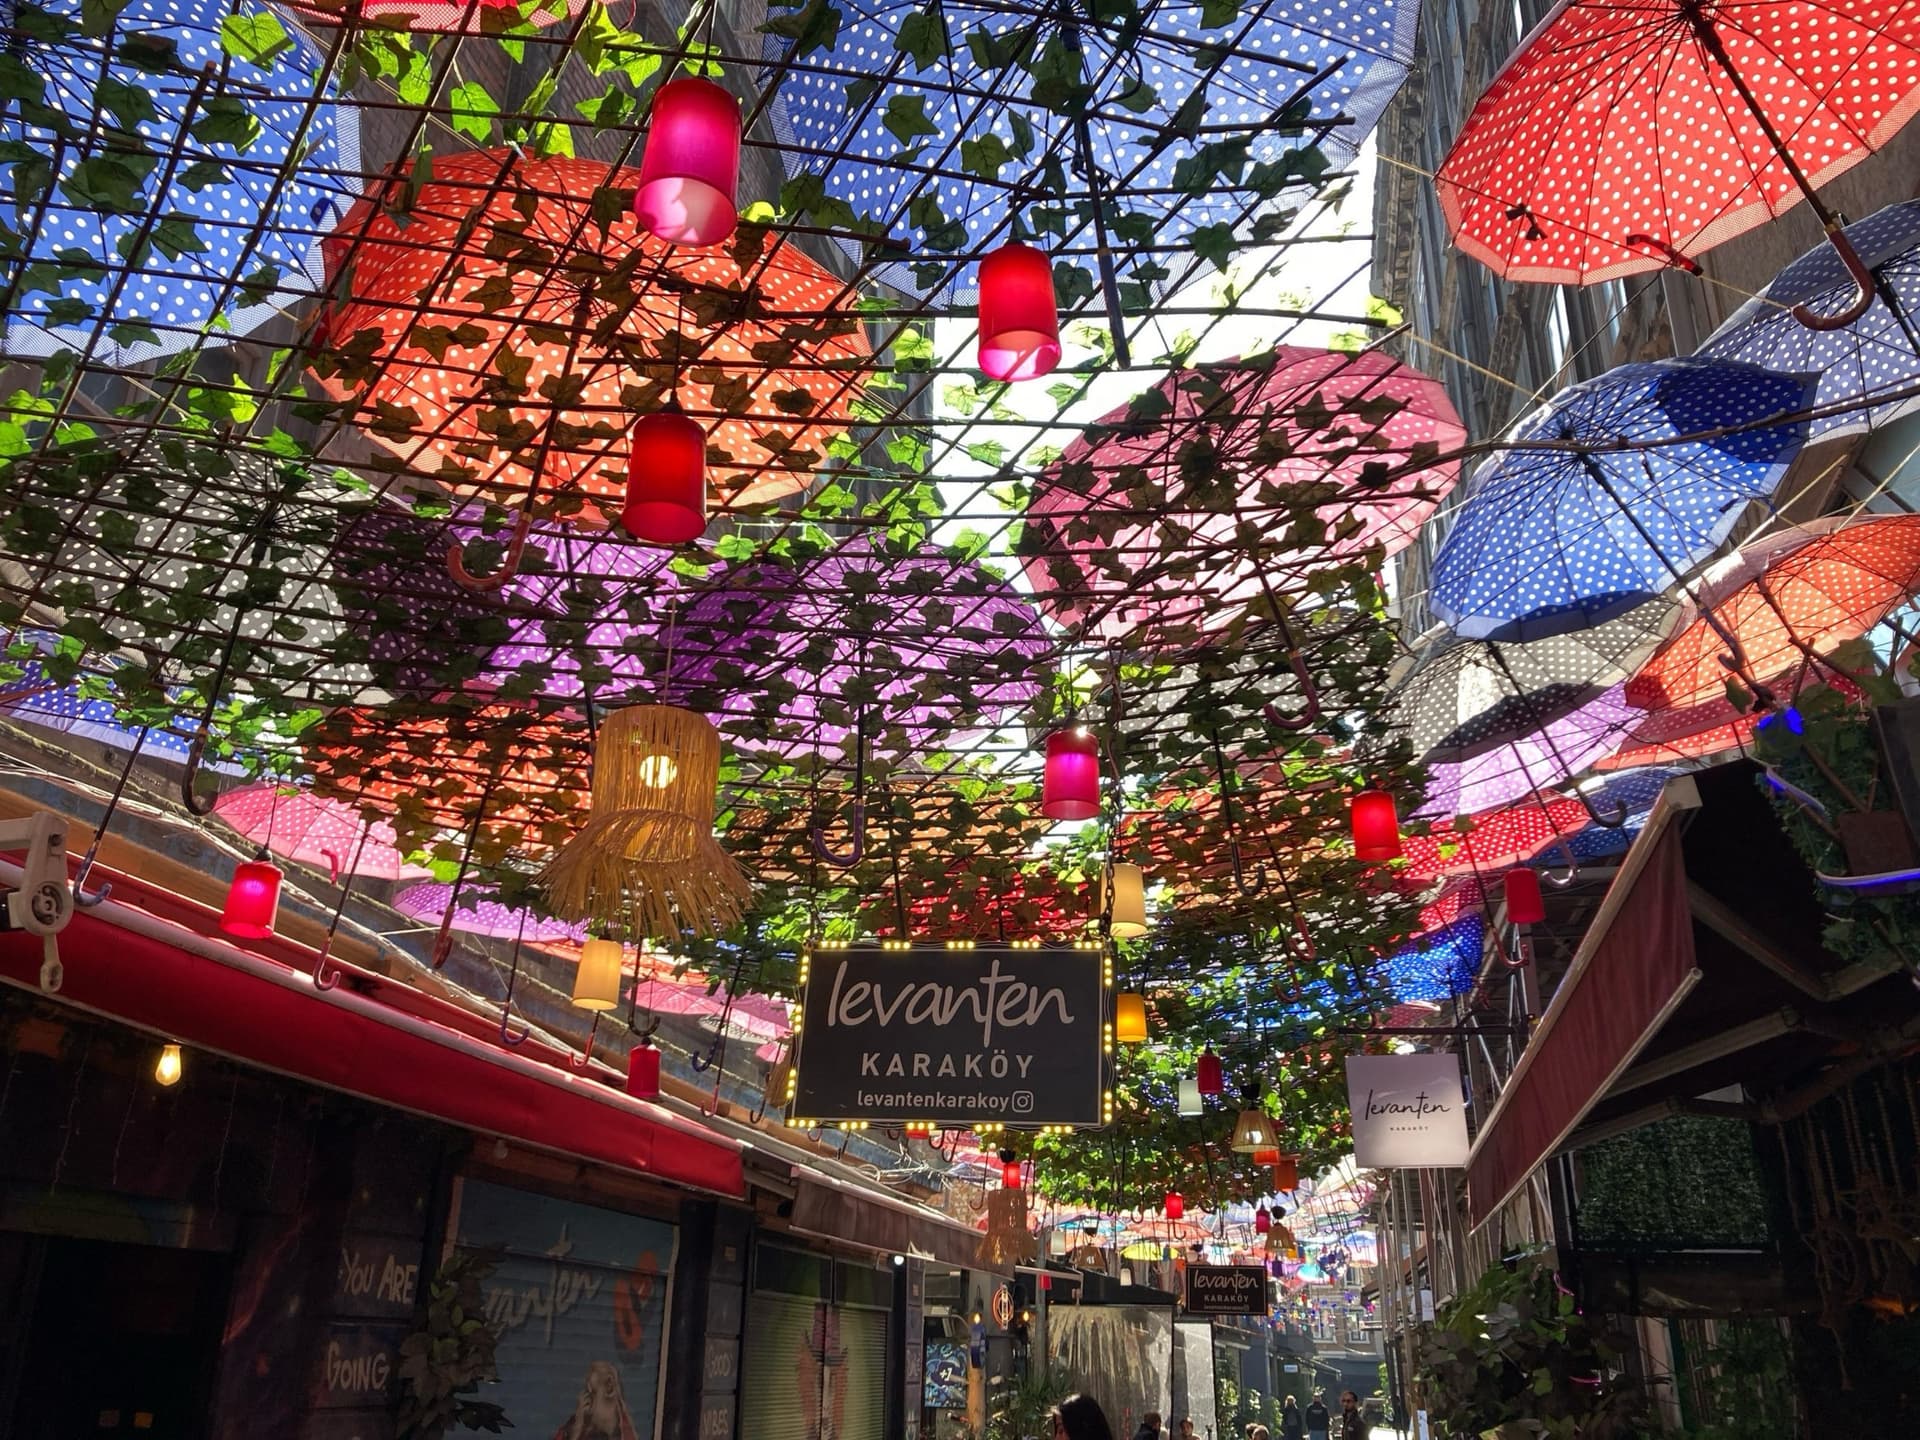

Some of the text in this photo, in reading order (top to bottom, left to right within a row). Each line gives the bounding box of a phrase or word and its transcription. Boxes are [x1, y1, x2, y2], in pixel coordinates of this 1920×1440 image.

[827, 959, 1075, 1048] levanten
[861, 1048, 1035, 1079] KARAKÖY
[857, 1090, 1010, 1113] levantenkarakoy
[1364, 1088, 1452, 1121] levanten
[341, 1248, 419, 1305] YOU ARE
[1193, 1269, 1259, 1294] levanten
[327, 1339, 391, 1393] GOING
